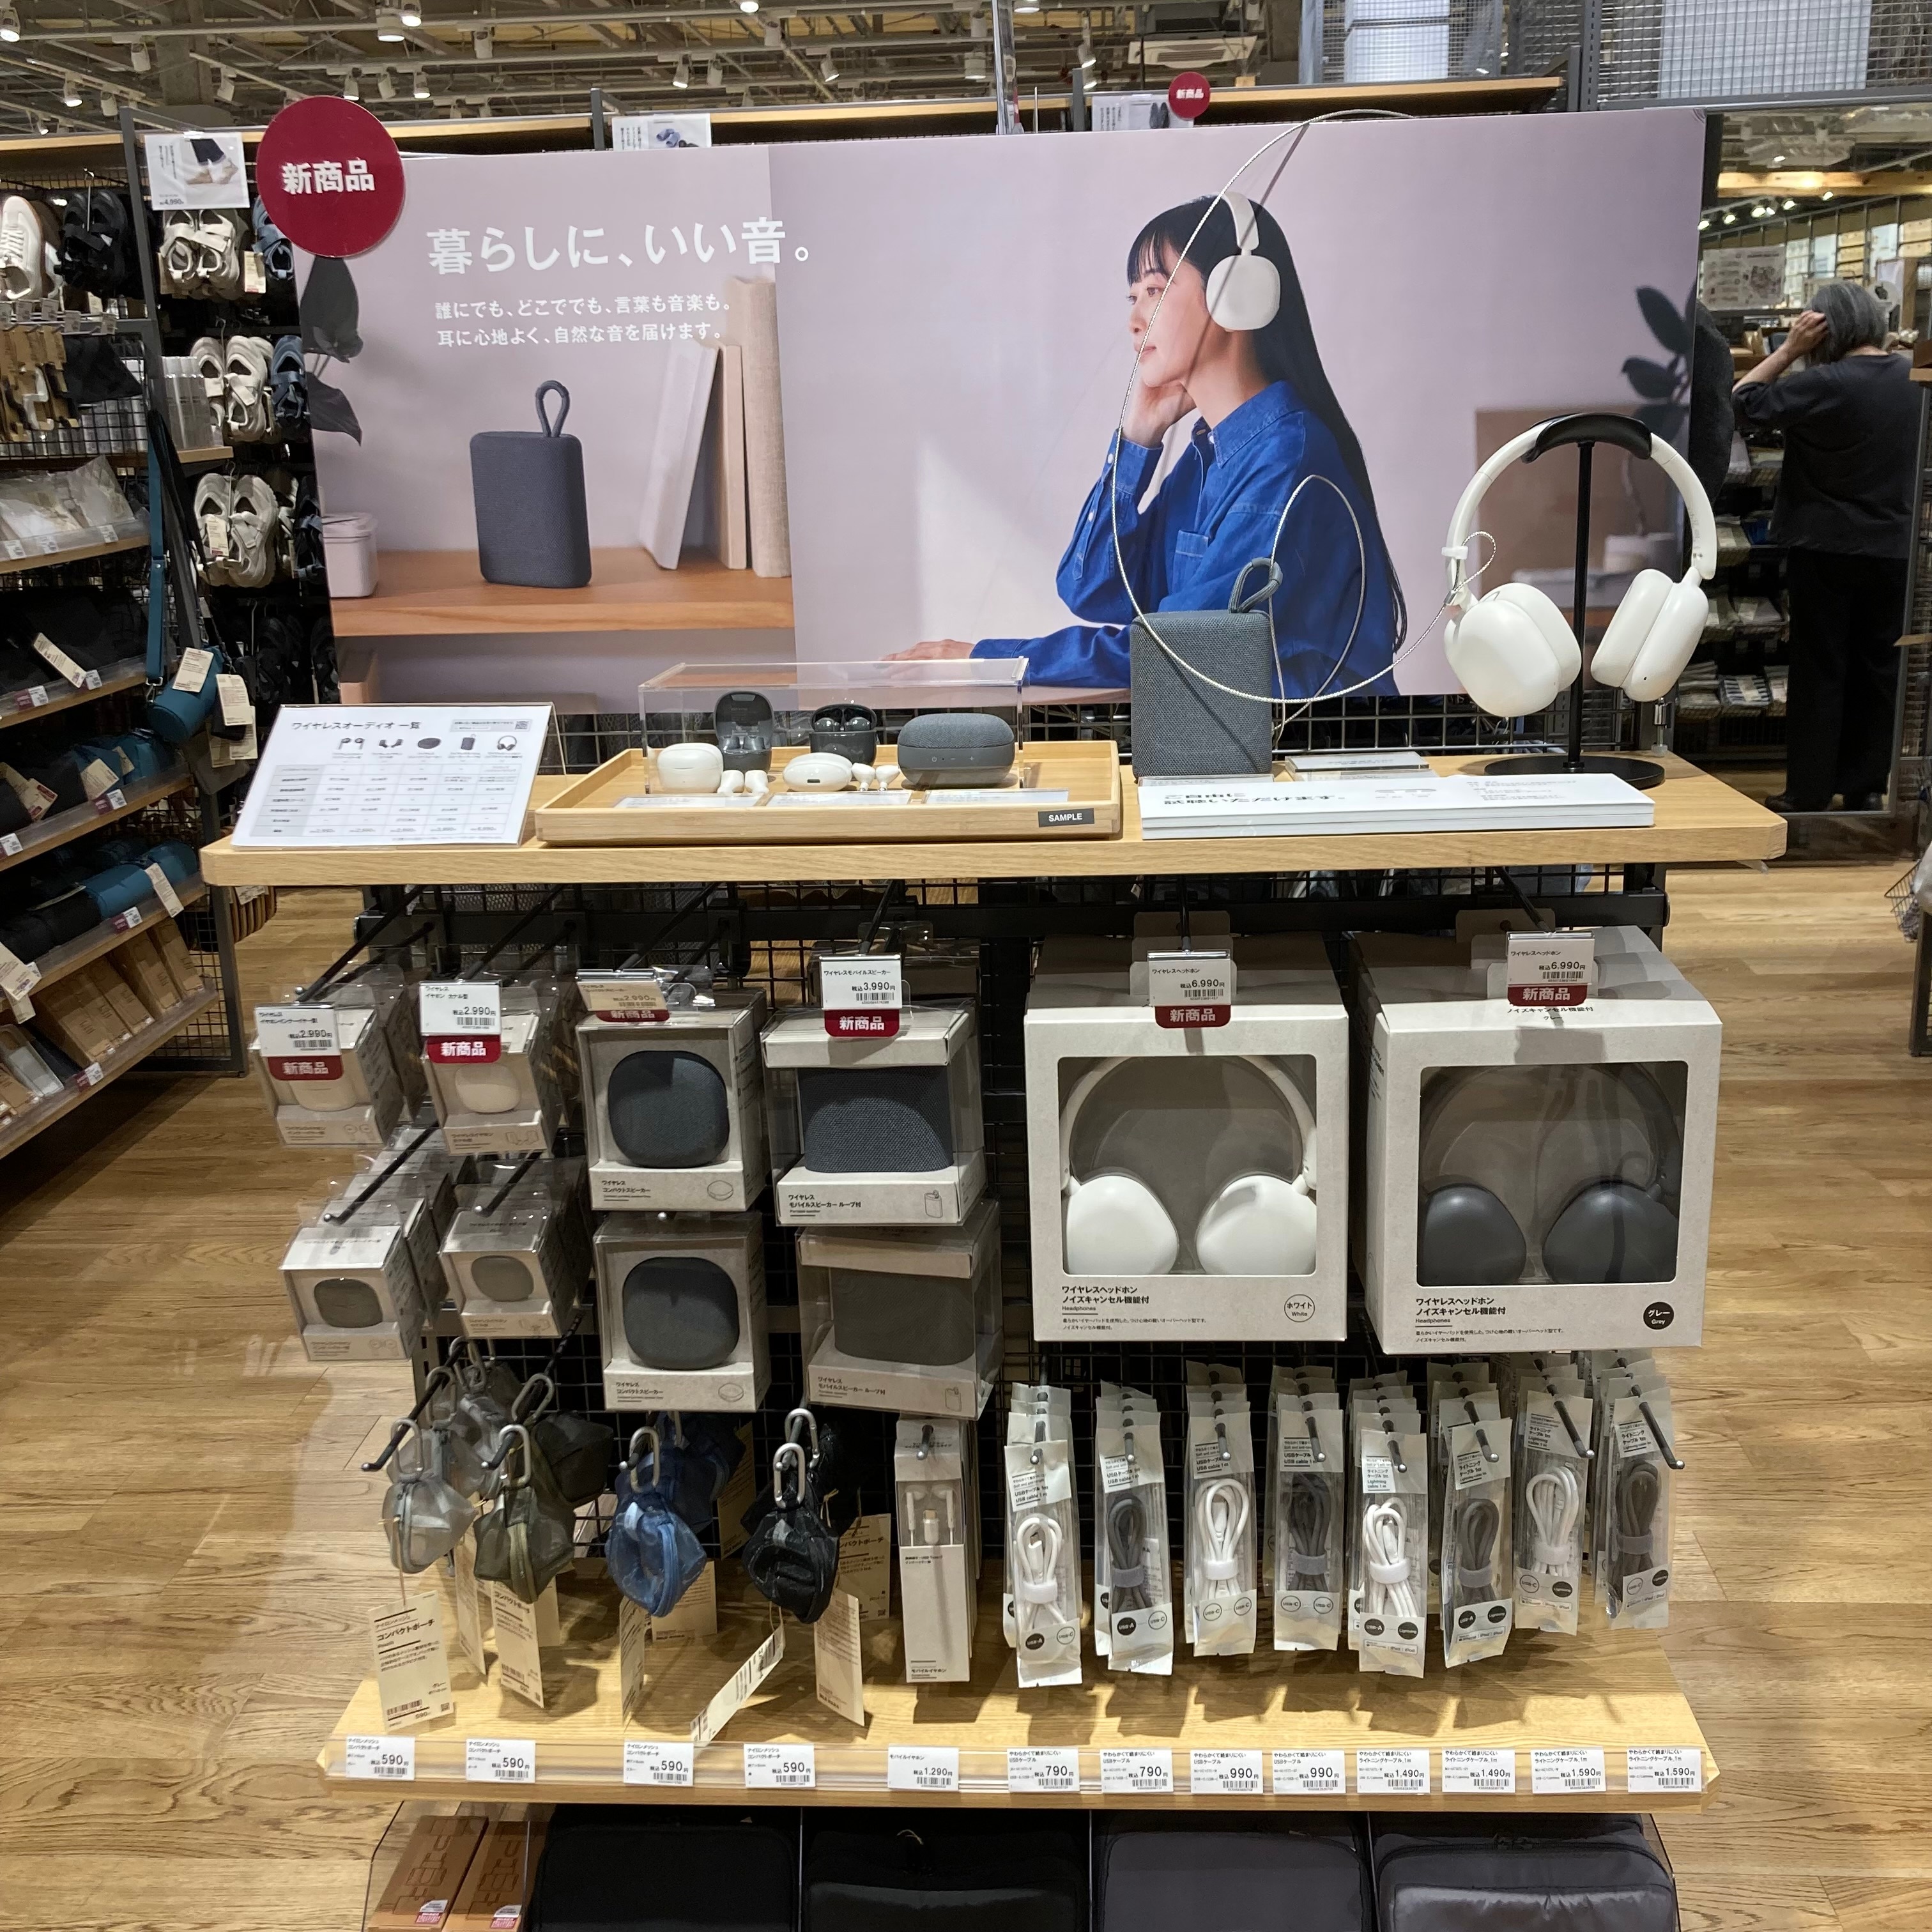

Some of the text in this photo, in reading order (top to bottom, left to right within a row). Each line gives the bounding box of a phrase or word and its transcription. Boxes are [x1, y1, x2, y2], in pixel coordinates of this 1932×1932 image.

[282, 159, 376, 195] 新商品
[426, 216, 809, 275] 暮らしに、いい音。
[435, 293, 731, 320] 誰にでも、どこででも、言葉も音楽も。
[438, 322, 721, 348] 耳に心地よく、自然な音を届けます。
[1048, 813, 1083, 822] SAMPLE
[1522, 987, 1570, 1000] 新商品
[611, 1010, 656, 1018] 新商品
[1170, 1008, 1216, 1022] 新商品
[839, 1016, 884, 1030] 新商品
[441, 1041, 486, 1056] 新商品
[282, 1061, 329, 1075] 新商品
[1062, 1296, 1149, 1304] ノイズキャンセル機能付
[1416, 1298, 1494, 1306] ワイヤレスヘッドホン
[1416, 1307, 1506, 1316] ノイズキャンセル機能付
[839, 1537, 884, 1549] ンパクトポーチ
[376, 1618, 435, 1641] コンパクトポーチ
